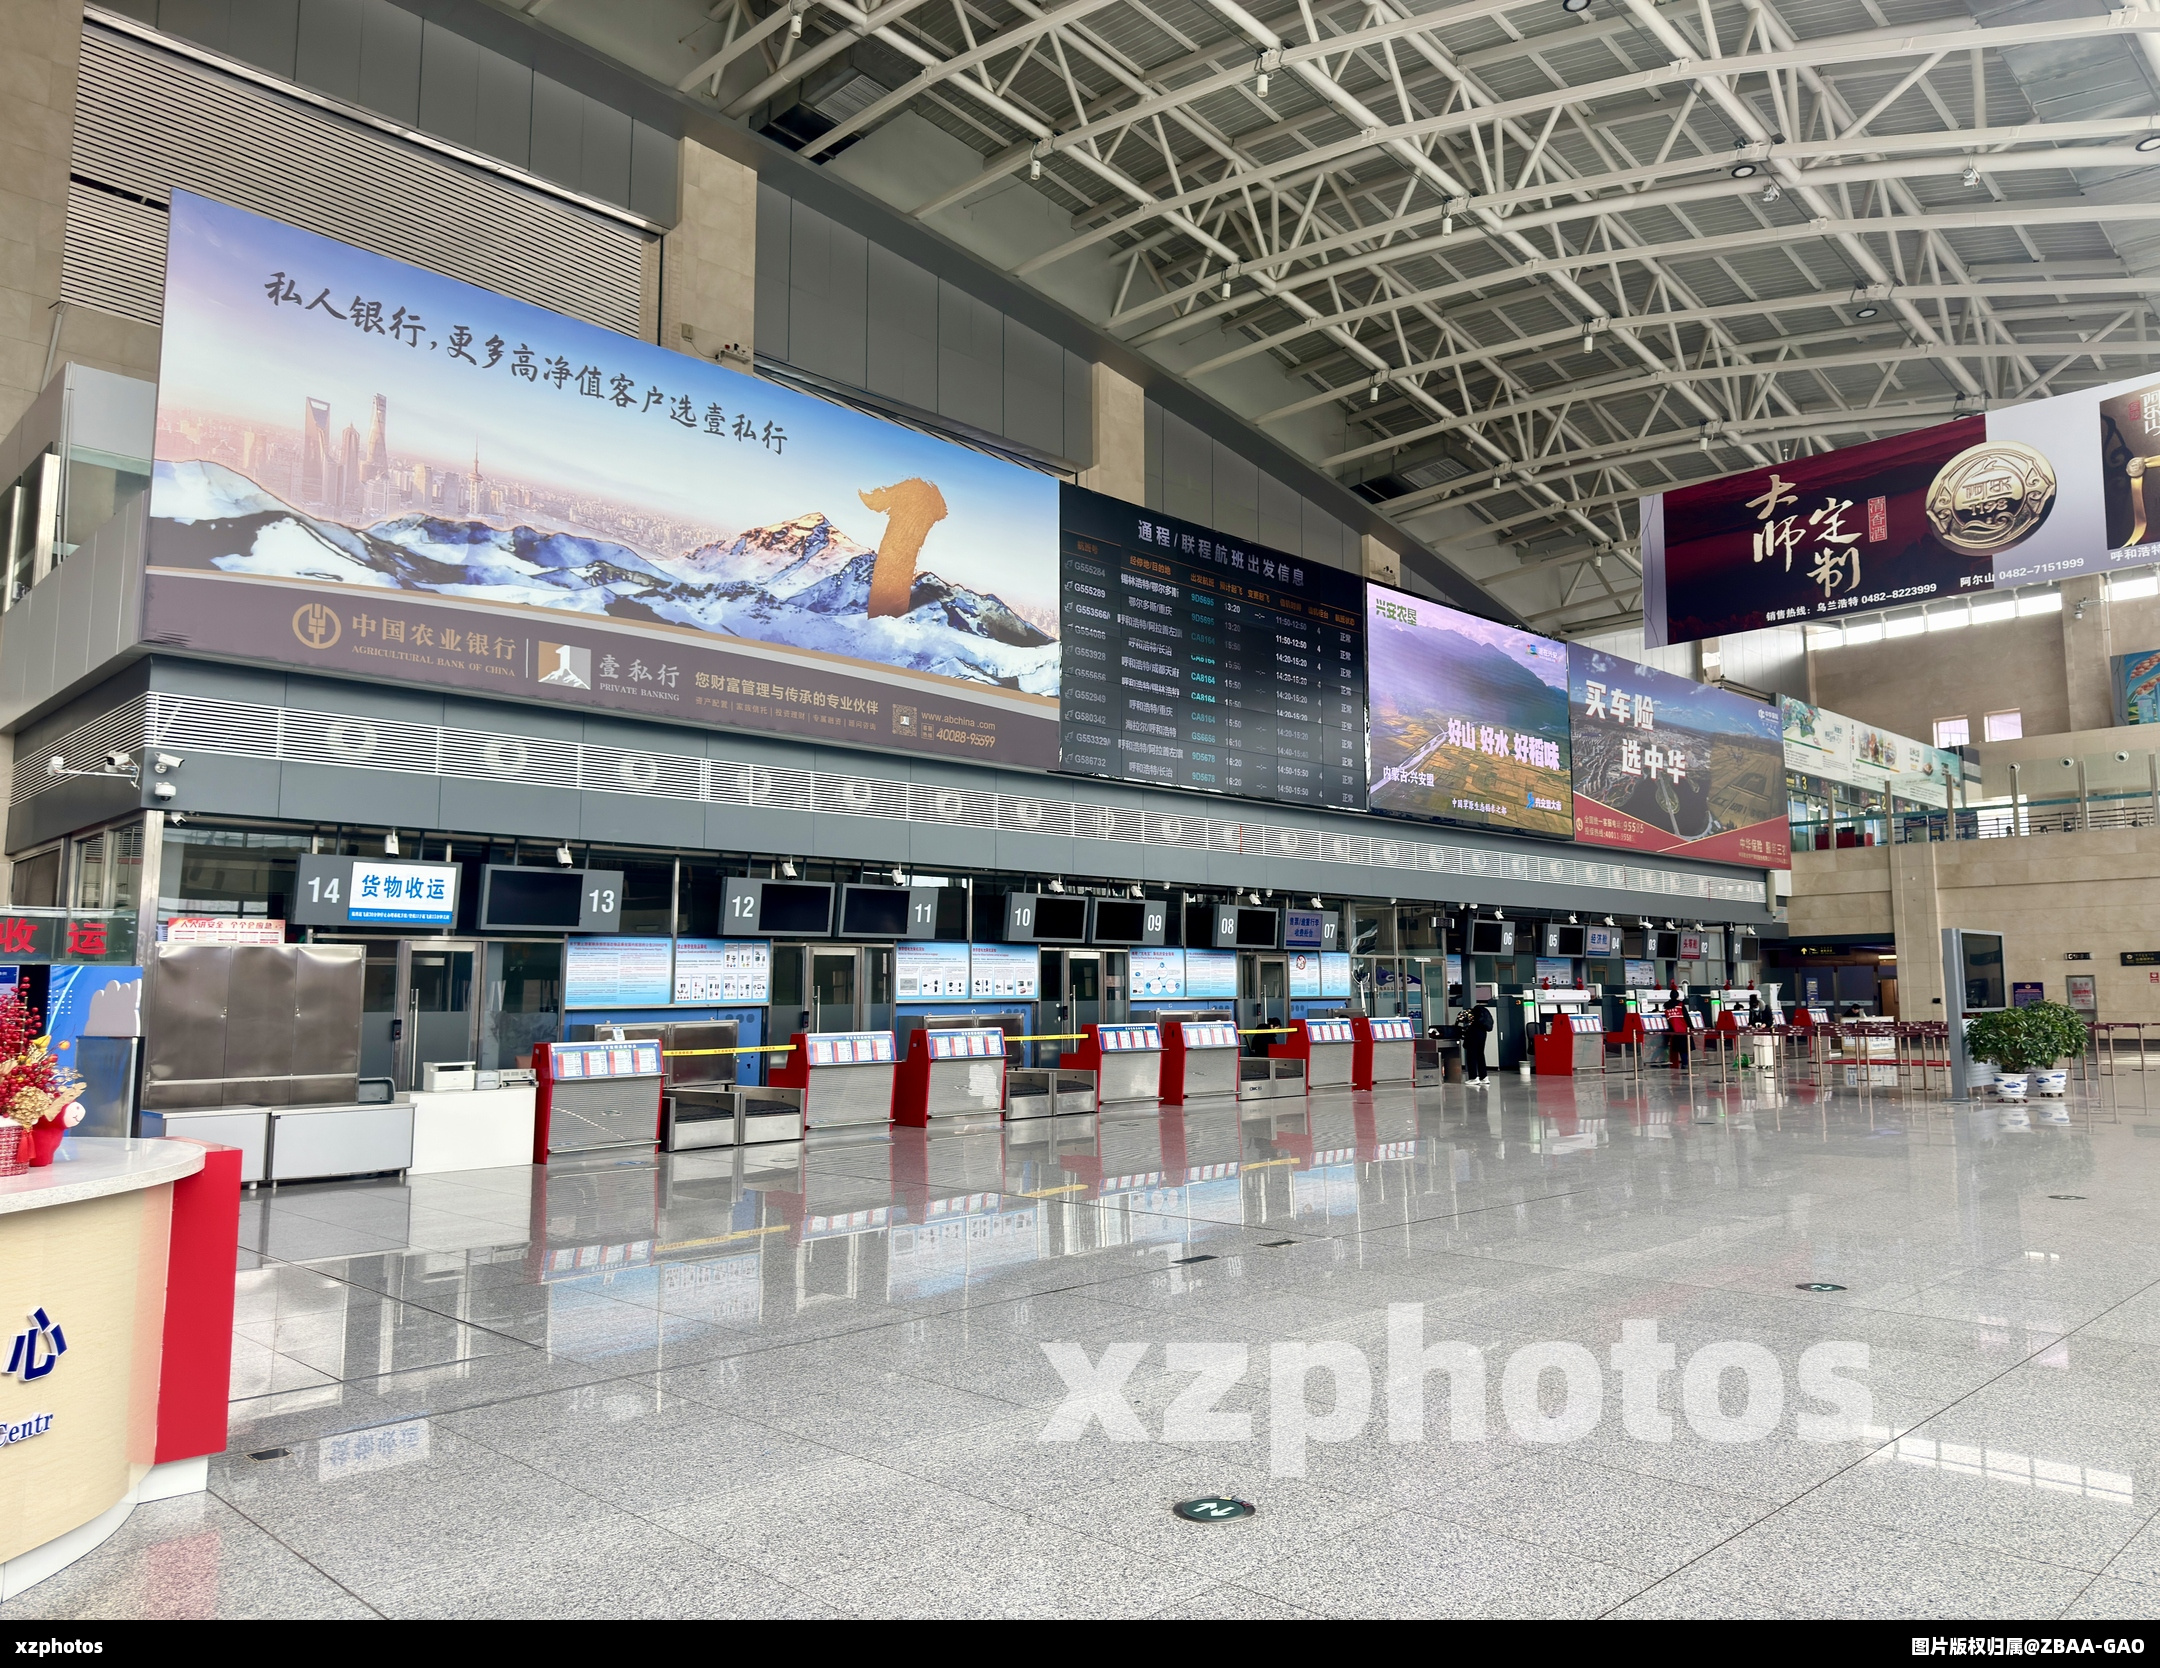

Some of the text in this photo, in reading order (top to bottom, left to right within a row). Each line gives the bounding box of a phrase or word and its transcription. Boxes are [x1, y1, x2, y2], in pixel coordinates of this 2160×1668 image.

[1868, 497, 1887, 541] 清香酒
[1959, 558, 2085, 588] 阿尔山 0482-7151999
[1074, 562, 1105, 578] G555284
[1224, 602, 1242, 614] 13:20
[1276, 616, 1307, 631] 11:50-12:50
[1816, 596, 1858, 612] 乌兰浩特
[1861, 583, 1937, 604] 0482-8223999
[1074, 583, 1106, 598] G555289
[1224, 622, 1242, 632] 13:20
[1276, 634, 1307, 649] 11:50-12:50
[1375, 598, 1417, 627] 兴安农垦
[352, 613, 516, 661] 中国农业银行
[352, 645, 516, 677] AGRICULTURAL BANK OF CHINA
[599, 654, 680, 688] 壹私行
[1276, 652, 1308, 667] 14:20-15:20
[1074, 646, 1106, 661] G553928
[1191, 672, 1215, 684] CA8164
[1224, 678, 1242, 690] 15:50
[1276, 690, 1308, 704] 14:20-15:20
[1276, 672, 1308, 686] 14:20-15:20
[600, 682, 680, 702] PRIVATE BANKING
[695, 671, 879, 715] 您财富管理与传承的专业伙伴
[1074, 690, 1106, 704] G552949
[1191, 712, 1215, 724] CA8164
[1224, 718, 1242, 728] 15:50
[1277, 728, 1308, 740] 14:20-15:20
[1191, 692, 1215, 704] CA8164
[1276, 709, 1308, 722] 14:20-15:20
[1585, 679, 1654, 732] 买车险
[1074, 711, 1106, 724] G580342
[936, 728, 996, 748] 40088-95599
[1447, 718, 1561, 771] 好山 好水 好稻味
[1224, 757, 1242, 767] 16:20
[1277, 766, 1308, 778] 14:50-15:50
[1621, 738, 1686, 786] 选中华
[1074, 754, 1106, 767] G586732
[1224, 776, 1242, 786] 16:20
[1277, 784, 1308, 796] 14:50-15:50
[1802, 776, 1808, 791] 3
[307, 876, 341, 904] 14
[361, 873, 445, 900] 货物收运
[589, 889, 615, 914] 13
[732, 895, 755, 918] 12
[180, 920, 224, 929] 人人讲安全
[914, 903, 932, 924] 11
[1014, 907, 1031, 927] 10
[1147, 913, 1162, 932] 09
[1221, 917, 1234, 935] 08
[1324, 923, 1335, 939] 07
[1503, 931, 1513, 946] 06
[1549, 934, 1558, 947] 05
[1590, 933, 1608, 946] 经济舱
[1612, 937, 1619, 949] 04
[1649, 939, 1656, 951] 03
[1683, 938, 1698, 950] 头等舱
[1701, 941, 1708, 954] 02
[1735, 943, 1741, 955] 01
[1, 1306, 67, 1382] 心
